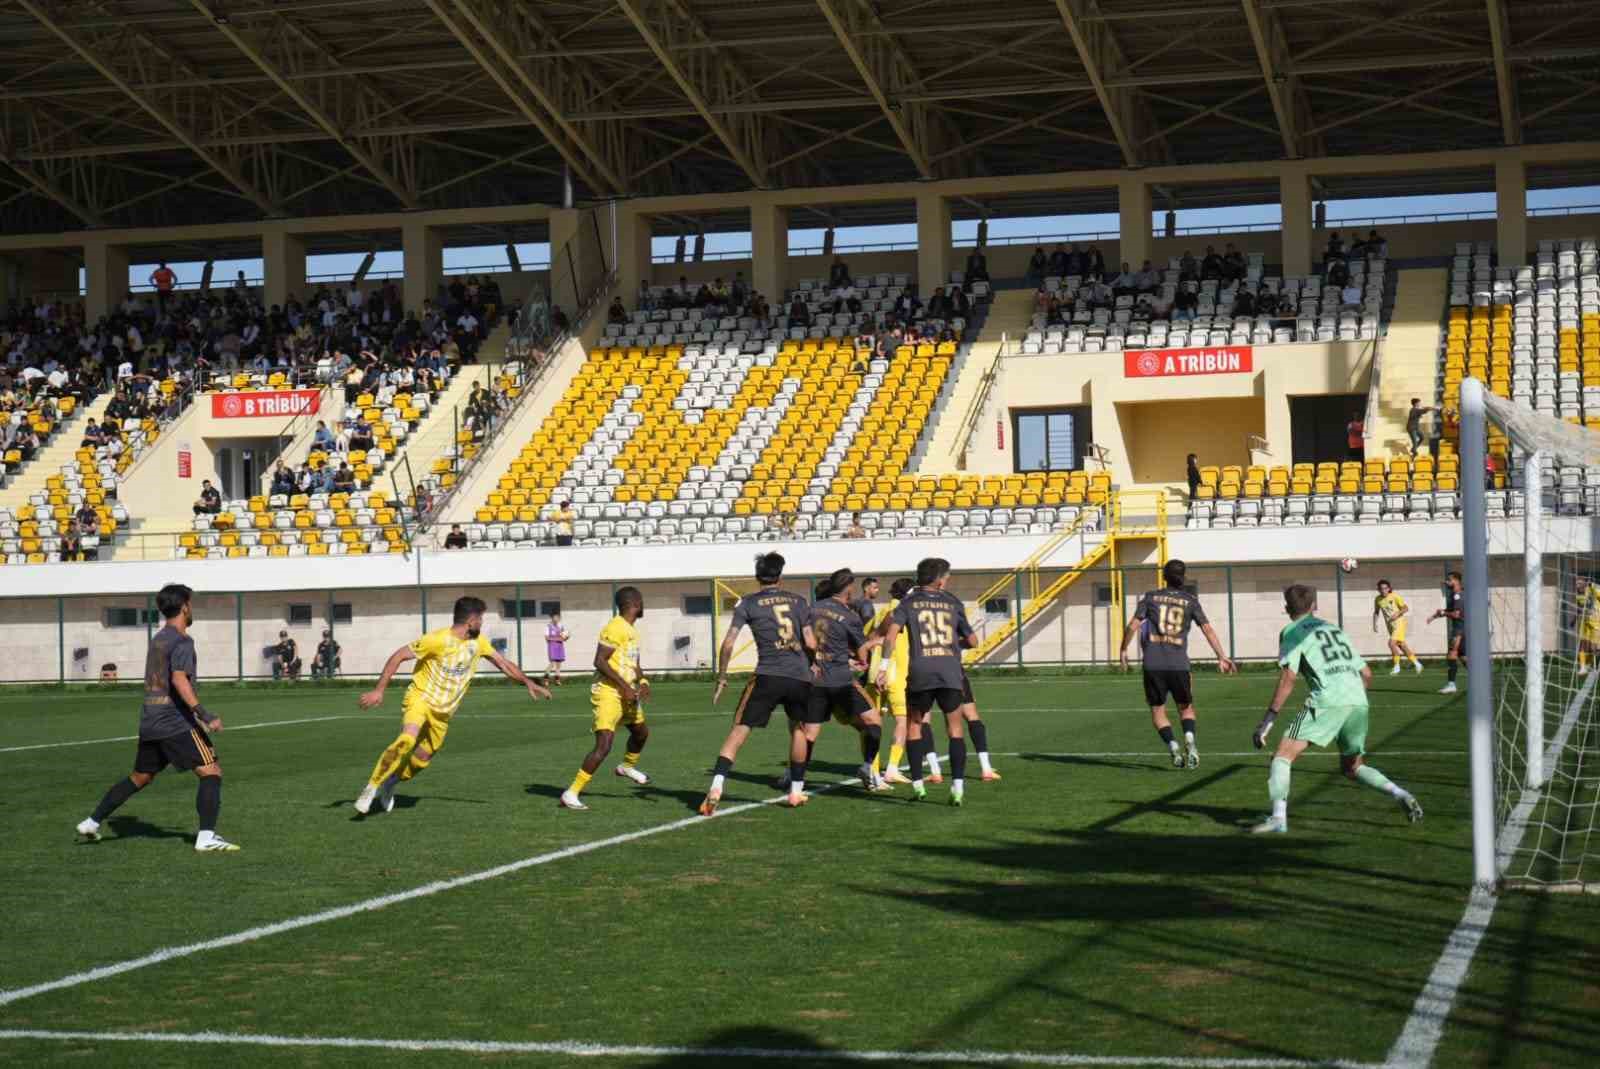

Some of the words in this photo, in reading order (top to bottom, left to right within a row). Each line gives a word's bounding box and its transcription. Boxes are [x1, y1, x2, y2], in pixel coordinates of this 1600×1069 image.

[1164, 356, 1175, 373] A
[1178, 350, 1240, 373] TRİBÜN
[245, 399, 255, 415] B
[257, 394, 311, 414] TRİBÜN
[773, 604, 794, 642] 5
[918, 610, 953, 646] 35
[1158, 604, 1185, 636] 19
[1315, 629, 1352, 662] 25
